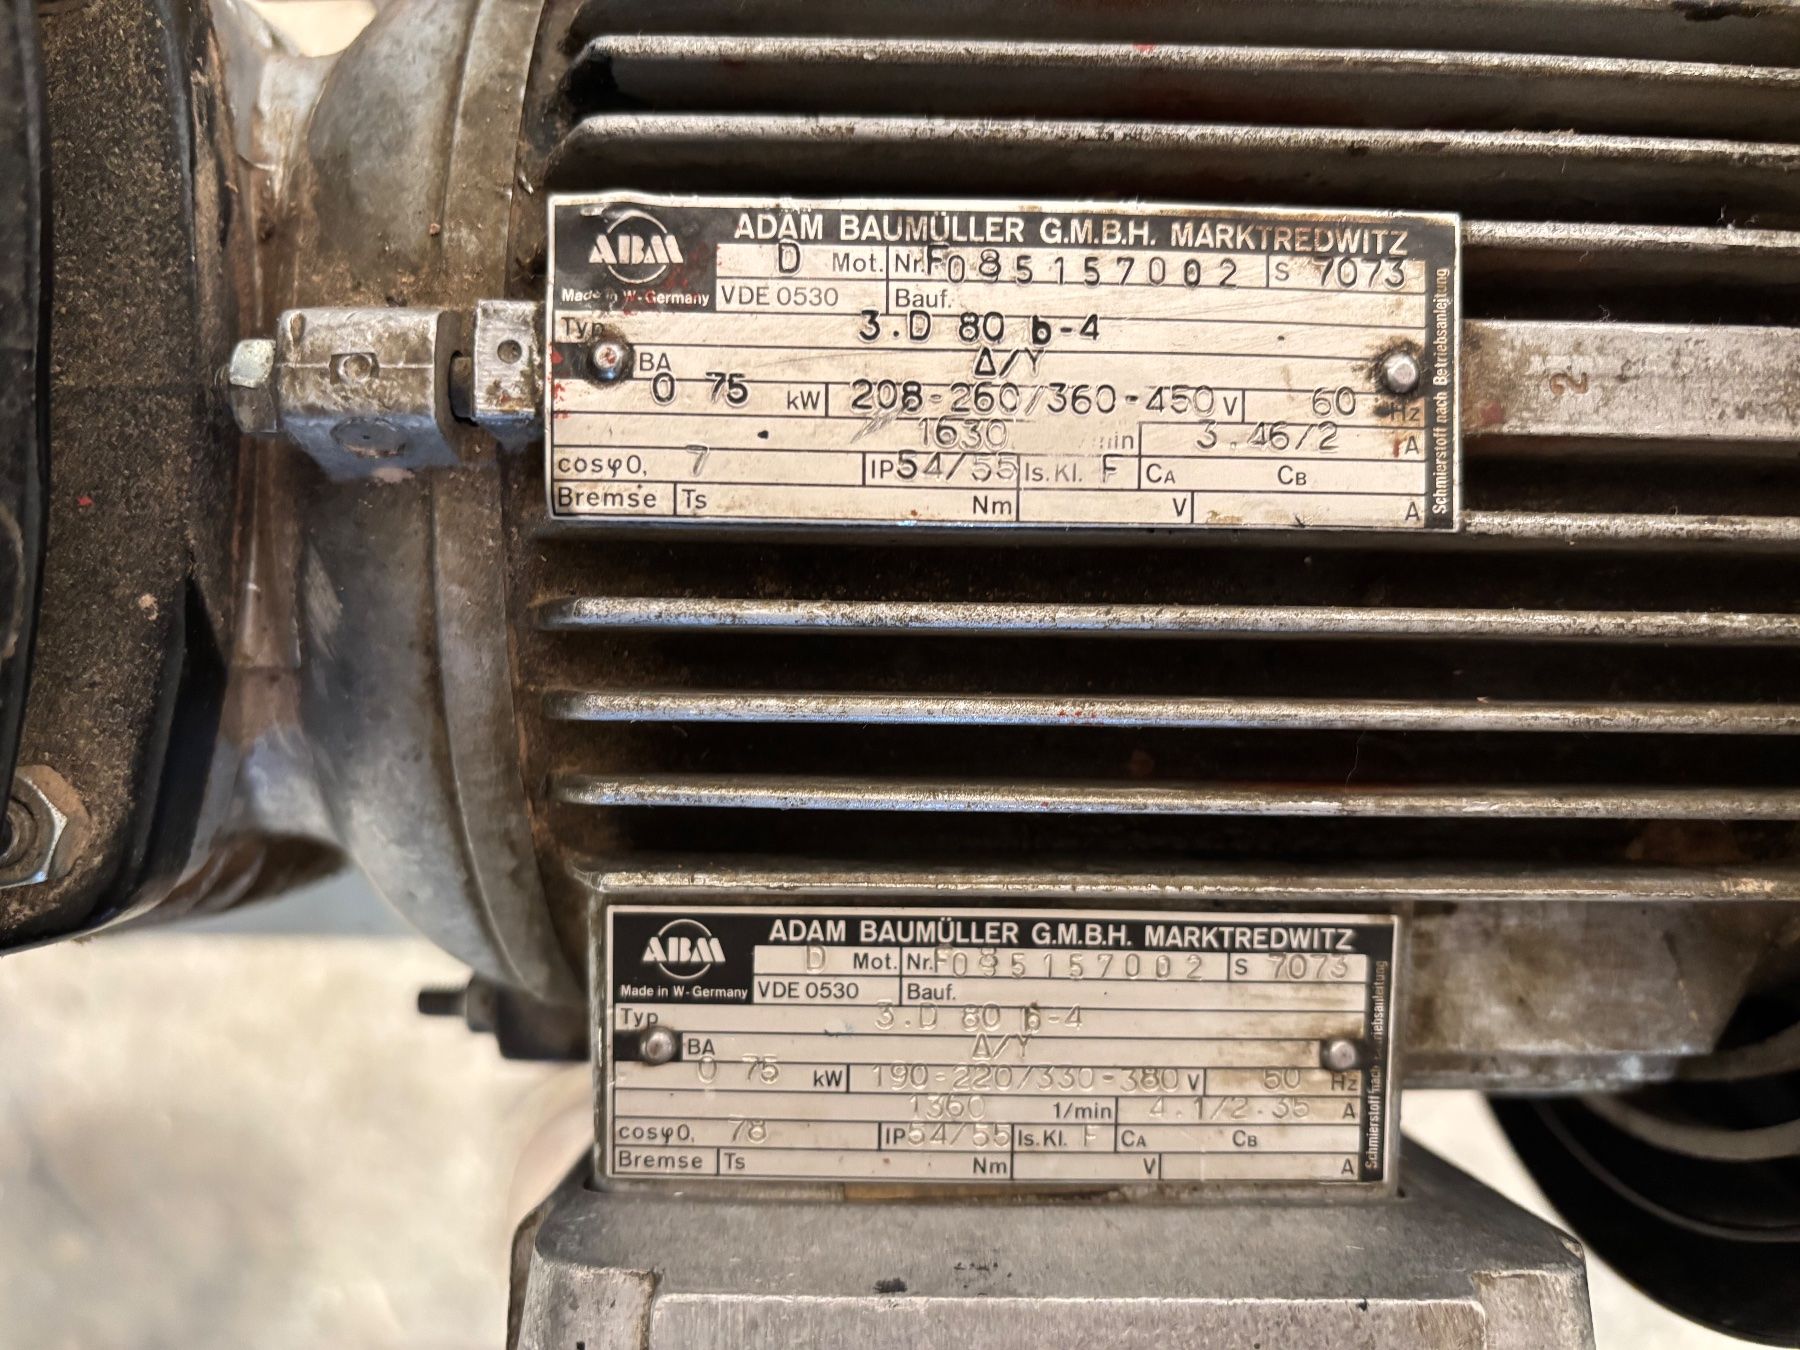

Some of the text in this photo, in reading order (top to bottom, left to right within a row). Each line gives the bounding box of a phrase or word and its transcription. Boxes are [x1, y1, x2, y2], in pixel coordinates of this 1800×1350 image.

[734, 212, 1408, 256] ADAM BAUMÜLLER G.M.B.H. MARKTREDWITZ
[589, 234, 684, 264] ABM
[832, 252, 884, 273] Mot.
[1312, 256, 1405, 288] 7073
[562, 288, 601, 302] Made
[721, 286, 838, 307] VDE 0530
[895, 288, 951, 308] Bauf.
[958, 311, 1005, 343] 80
[639, 352, 672, 372] BA
[787, 391, 820, 411] kW
[1312, 386, 1356, 417] 60
[1432, 268, 1450, 515] Schmierstoff nach Betriebsanleitung
[919, 416, 1007, 449] 1630
[1404, 436, 1420, 454] A
[558, 487, 657, 509] Bremse
[681, 488, 1012, 515] Ts Nm
[1172, 498, 1420, 521] V A
[769, 917, 1353, 949] ADAM BAUMÜLLER G.M.B.H. MARKTREDWITZ
[643, 936, 726, 963] ABM
[853, 953, 897, 970] Mot.
[1269, 952, 1350, 980] 7073
[620, 984, 654, 997] Made
[657, 985, 669, 997] in
[758, 981, 859, 999] VDE 0530
[907, 983, 956, 1000] Bauf.
[620, 1008, 659, 1027] Typ
[961, 1002, 1001, 1031] 80
[687, 1038, 715, 1055] BA
[813, 1070, 843, 1087] kW
[1330, 1071, 1358, 1091] Hz
[910, 1092, 1112, 1121] 1360 1/min
[1342, 1103, 1356, 1119] A
[728, 1114, 768, 1144] 78
[1365, 1095, 1380, 1169] Schmierstoff
[619, 1150, 703, 1169] Bremse
[724, 1152, 1007, 1174] Ts Nm
[1143, 1158, 1355, 1175] V A
